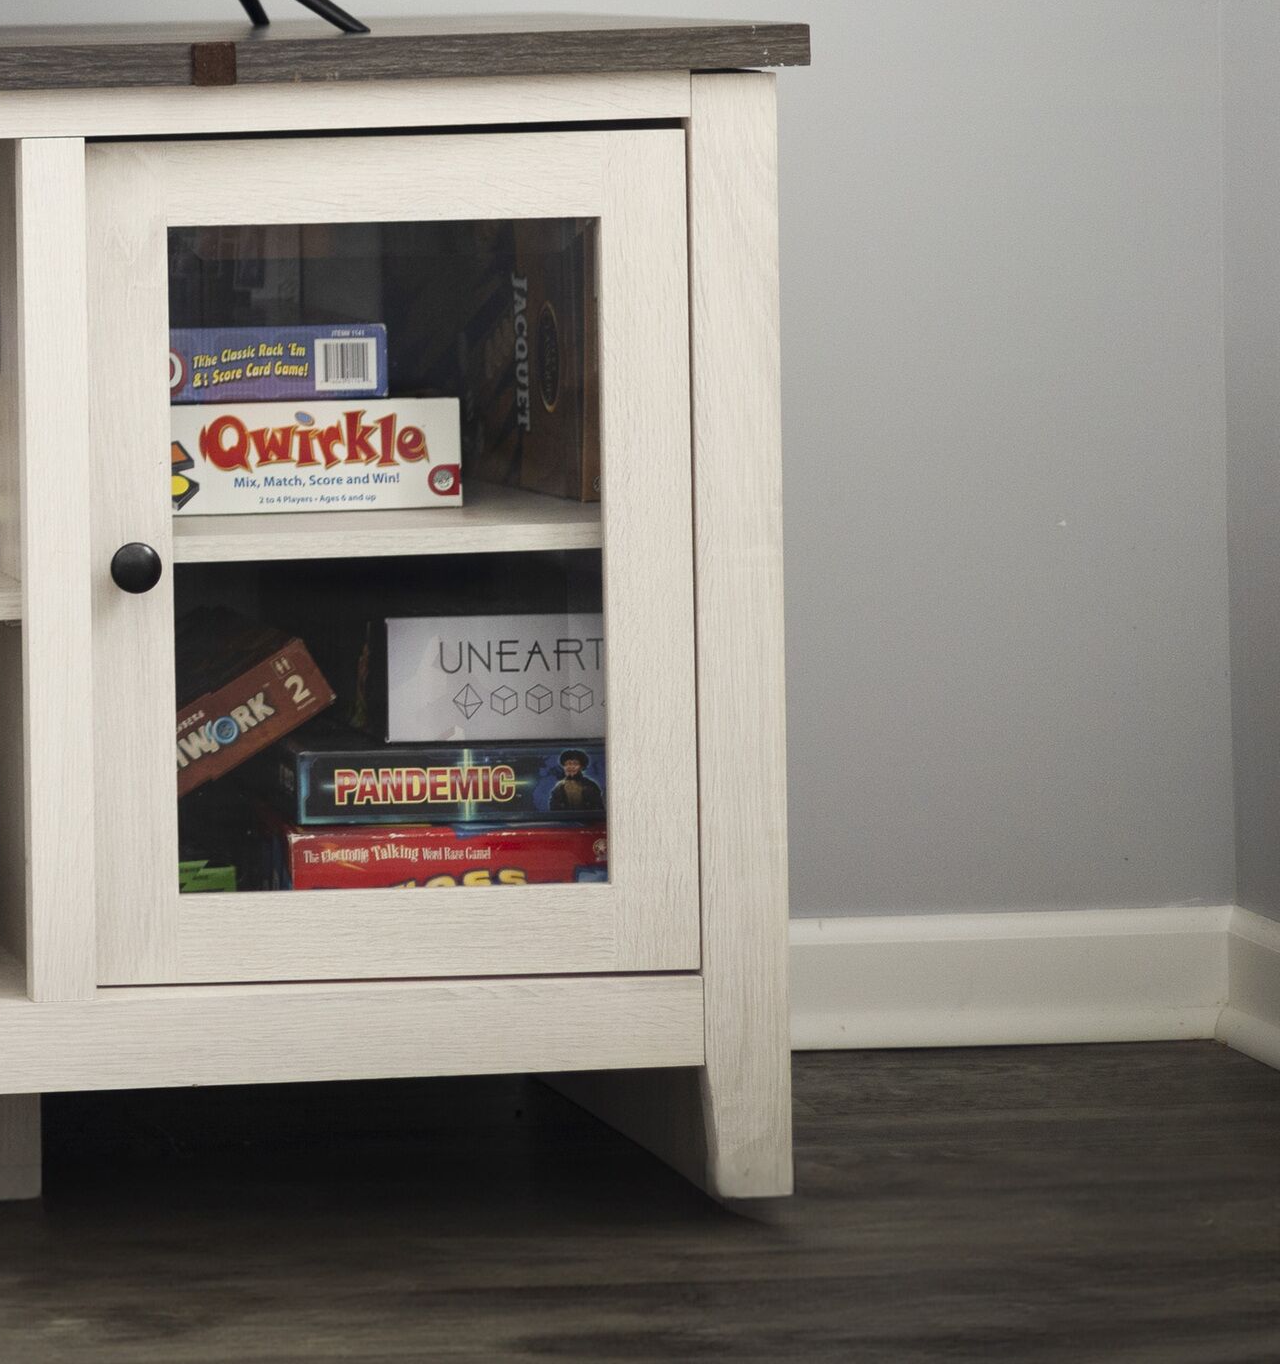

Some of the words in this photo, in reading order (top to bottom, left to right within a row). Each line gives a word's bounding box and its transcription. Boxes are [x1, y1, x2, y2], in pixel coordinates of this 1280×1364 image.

[221, 347, 256, 362] Classic
[258, 343, 284, 357] Rack
[212, 369, 242, 382] Score
[246, 363, 272, 378] Card
[274, 361, 309, 376] Game!
[199, 409, 430, 474] Qwirkle
[234, 477, 261, 488] Mix,
[264, 474, 306, 487] Match,
[309, 473, 343, 485] Score
[346, 473, 369, 485] and
[372, 472, 400, 484] Win!
[284, 495, 312, 505] Players
[320, 495, 340, 504] Ages
[348, 493, 364, 502] and
[284, 674, 311, 704] 2
[335, 765, 515, 805] PANDEMIC
[371, 844, 418, 862] Talking
